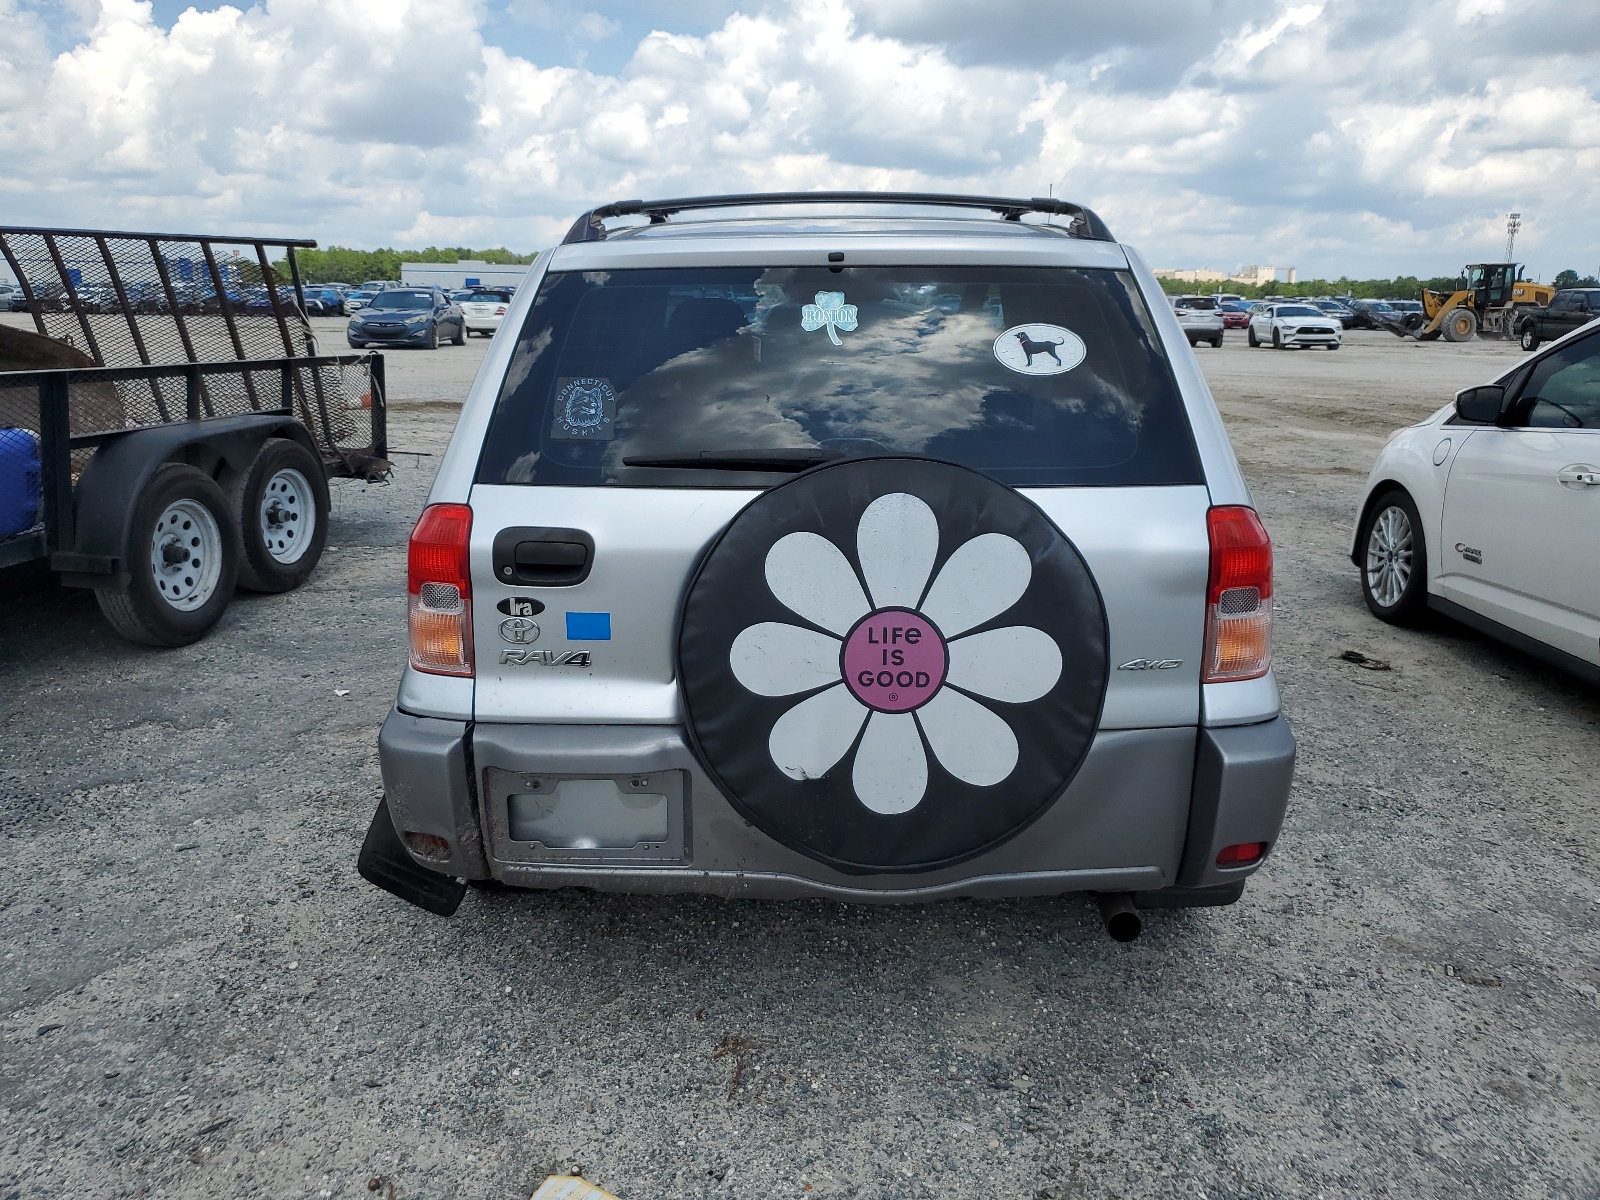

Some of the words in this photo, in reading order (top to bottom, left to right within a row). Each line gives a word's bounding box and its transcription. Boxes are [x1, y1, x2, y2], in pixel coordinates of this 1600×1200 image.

[805, 309, 855, 322] BOSTON
[557, 378, 615, 402] CONNECTICUT
[557, 416, 610, 436] HUSKIES
[509, 597, 533, 616] Ira
[499, 649, 592, 668] RAV4
[882, 648, 905, 665] IS
[1117, 657, 1183, 671] 4WD
[857, 670, 931, 688] GOOD
